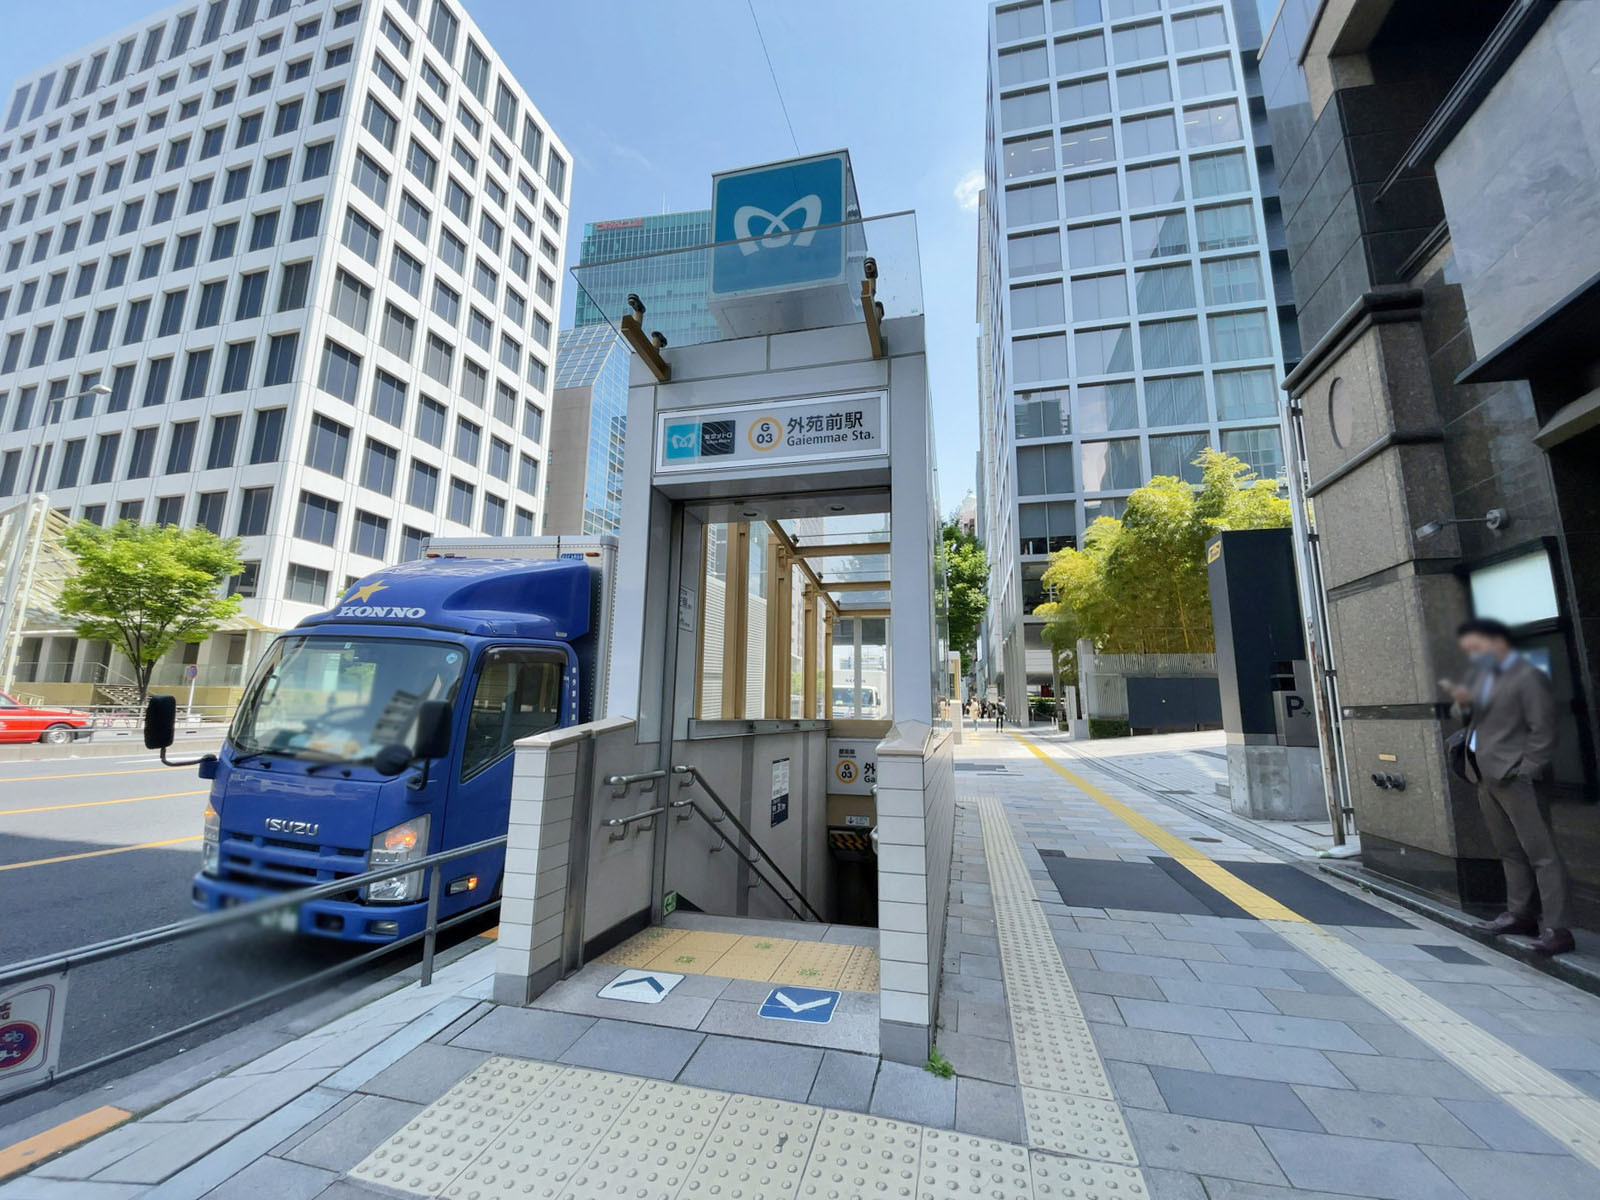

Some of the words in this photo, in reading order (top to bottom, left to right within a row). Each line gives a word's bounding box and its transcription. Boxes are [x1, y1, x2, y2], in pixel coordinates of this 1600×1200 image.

[760, 423, 770, 432] G
[787, 411, 863, 434] 外苑前駅
[757, 433, 773, 444] 03
[787, 433, 848, 447] Gaiemmae
[852, 430, 874, 441] Sta.
[336, 606, 426, 618] KONNO
[1286, 696, 1304, 717] P
[841, 771, 852, 779] 03
[265, 818, 319, 836] ISUZU
